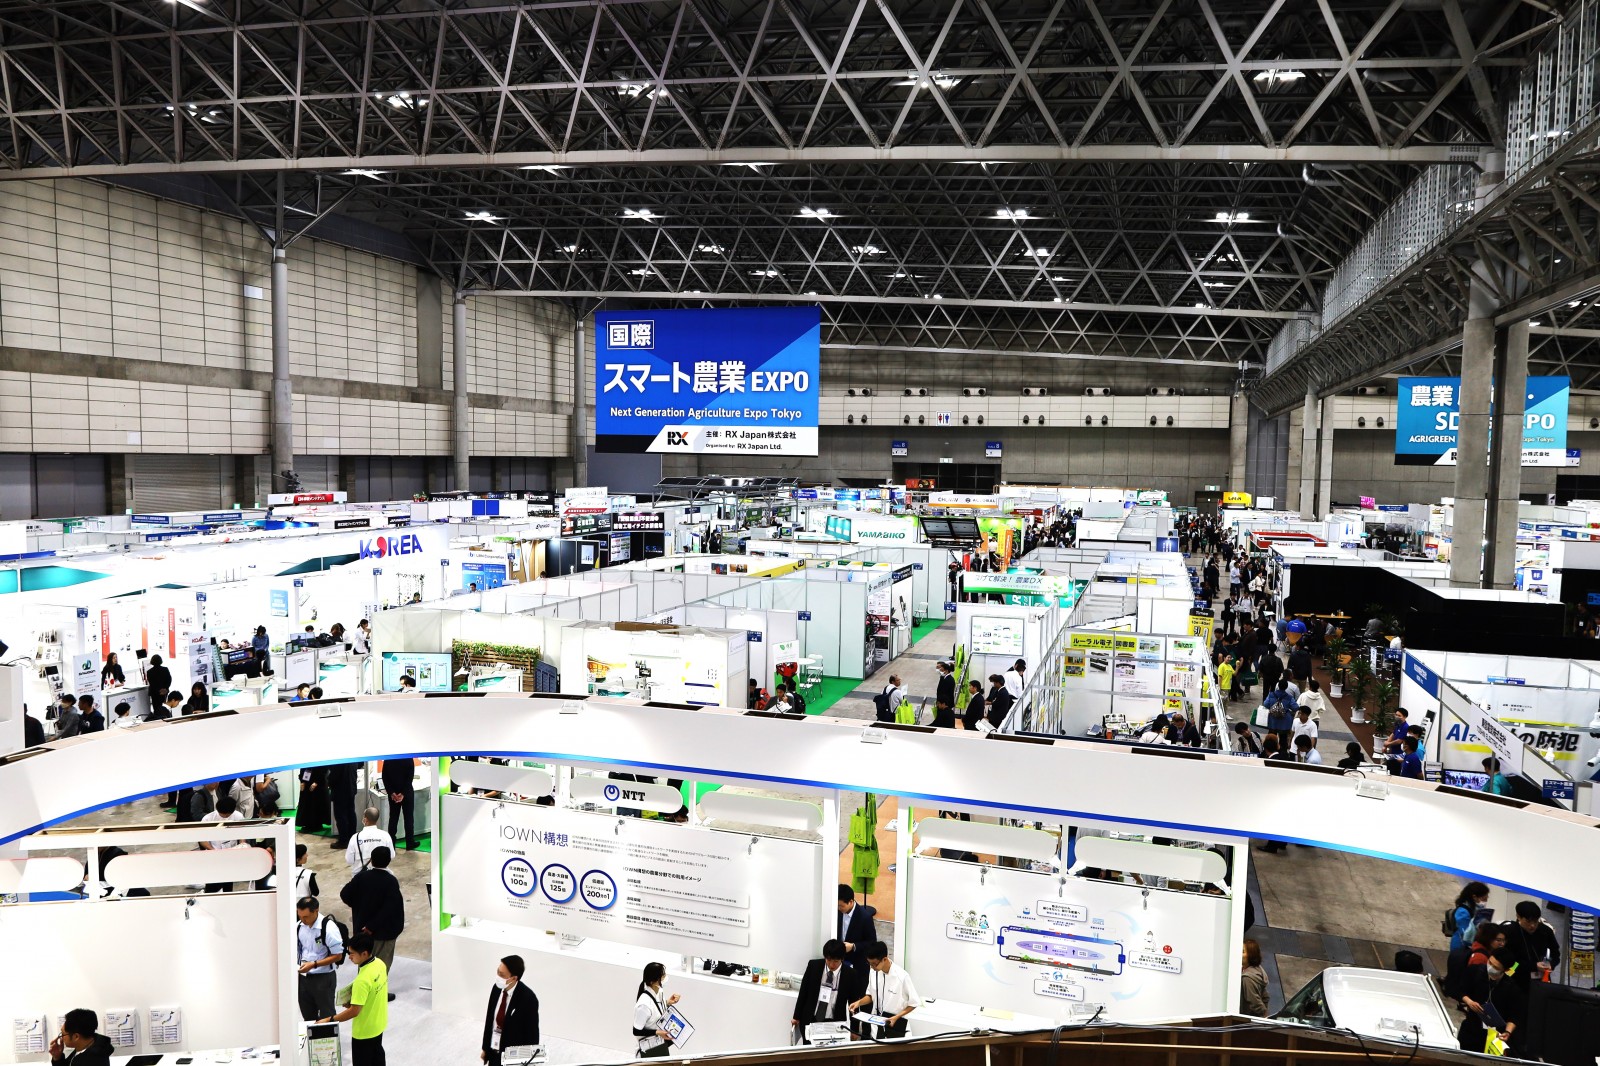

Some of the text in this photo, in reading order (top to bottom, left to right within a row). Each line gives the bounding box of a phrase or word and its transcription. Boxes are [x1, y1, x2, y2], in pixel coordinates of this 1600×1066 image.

[609, 324, 651, 347] 国際
[604, 360, 809, 394] スマート農業 EXPO
[1410, 385, 1453, 407] 農業
[610, 407, 802, 421] Next Generation Agriculture Expo Tokyo
[668, 431, 689, 446] RX
[725, 430, 738, 438] RX
[1408, 434, 1456, 443] AGRIGREEN
[748, 443, 769, 451] Japan
[857, 531, 906, 539] YAMABIKO
[359, 534, 423, 560] KOREA
[622, 789, 645, 802] NTT
[499, 825, 568, 848] IOWN構想
[510, 878, 528, 887] 100倍
[550, 884, 566, 893] 125倍
